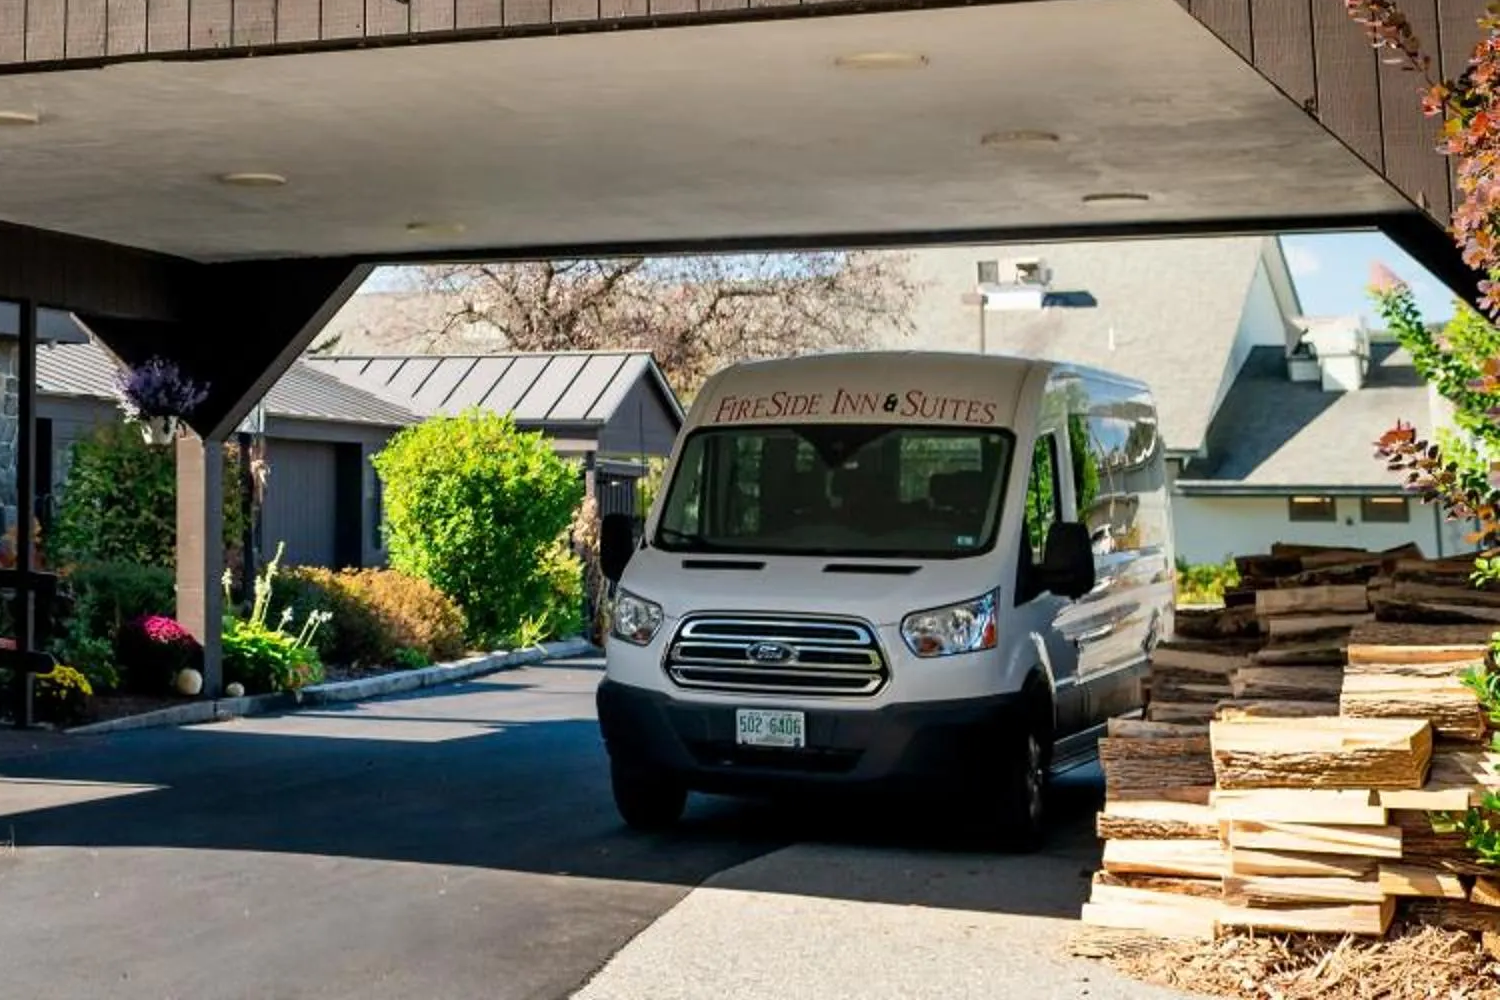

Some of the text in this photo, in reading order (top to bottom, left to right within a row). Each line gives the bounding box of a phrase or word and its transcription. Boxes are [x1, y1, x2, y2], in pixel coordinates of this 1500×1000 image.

[830, 387, 881, 415] INN
[883, 392, 899, 413] &
[900, 389, 998, 425] SUITES
[739, 715, 763, 733] 502
